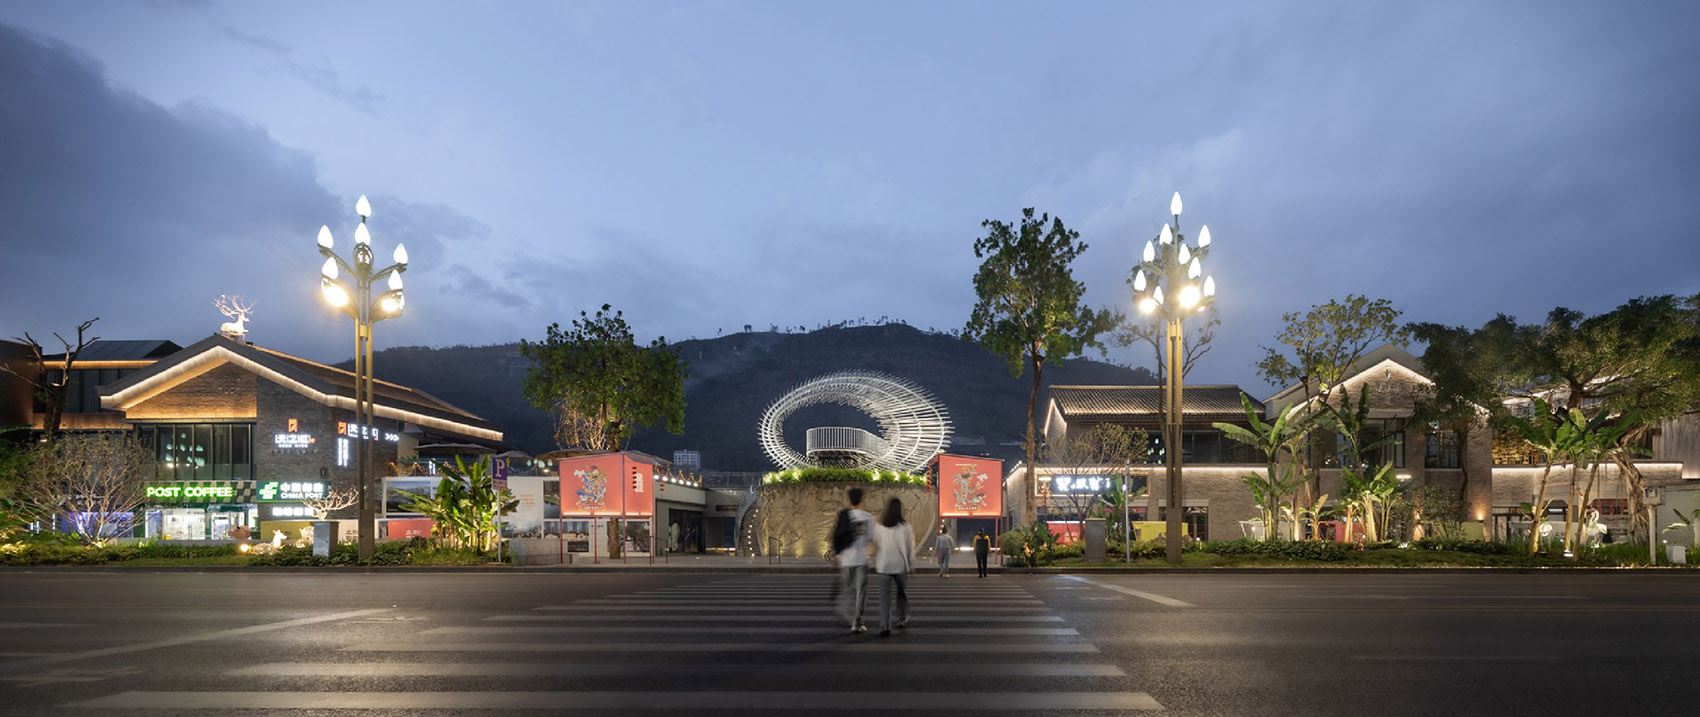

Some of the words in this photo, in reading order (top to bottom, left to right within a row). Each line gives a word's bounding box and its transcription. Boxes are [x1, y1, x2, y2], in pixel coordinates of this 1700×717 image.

[495, 459, 506, 478] P
[146, 486, 181, 498] POST
[184, 486, 233, 498] COFFEE
[280, 492, 304, 500] CHINA
[304, 492, 324, 500] POST
